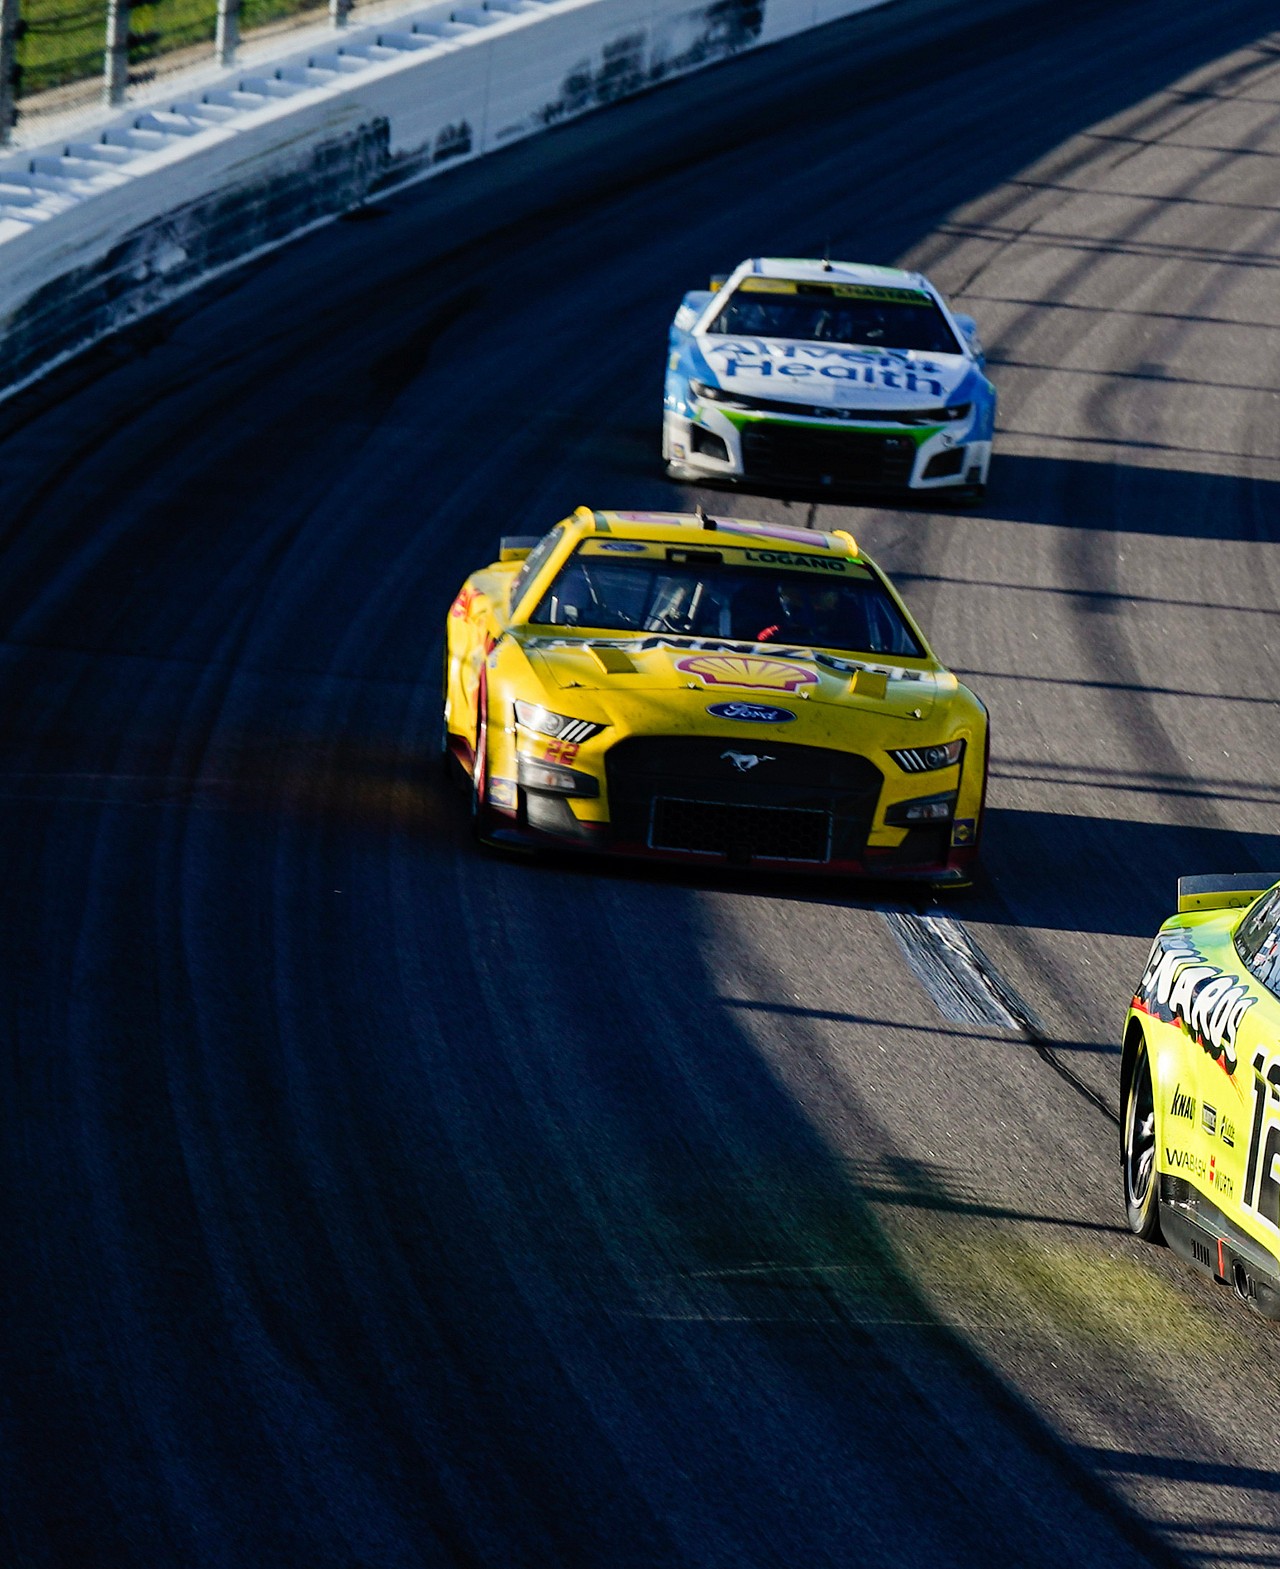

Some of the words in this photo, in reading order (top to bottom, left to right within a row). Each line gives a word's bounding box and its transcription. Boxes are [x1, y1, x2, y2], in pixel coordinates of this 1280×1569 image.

[726, 358, 943, 396] Health
[745, 551, 846, 572] LOGANO
[723, 702, 778, 721] Ford
[545, 740, 580, 765] 22
[1165, 1147, 1207, 1180] WABASH
